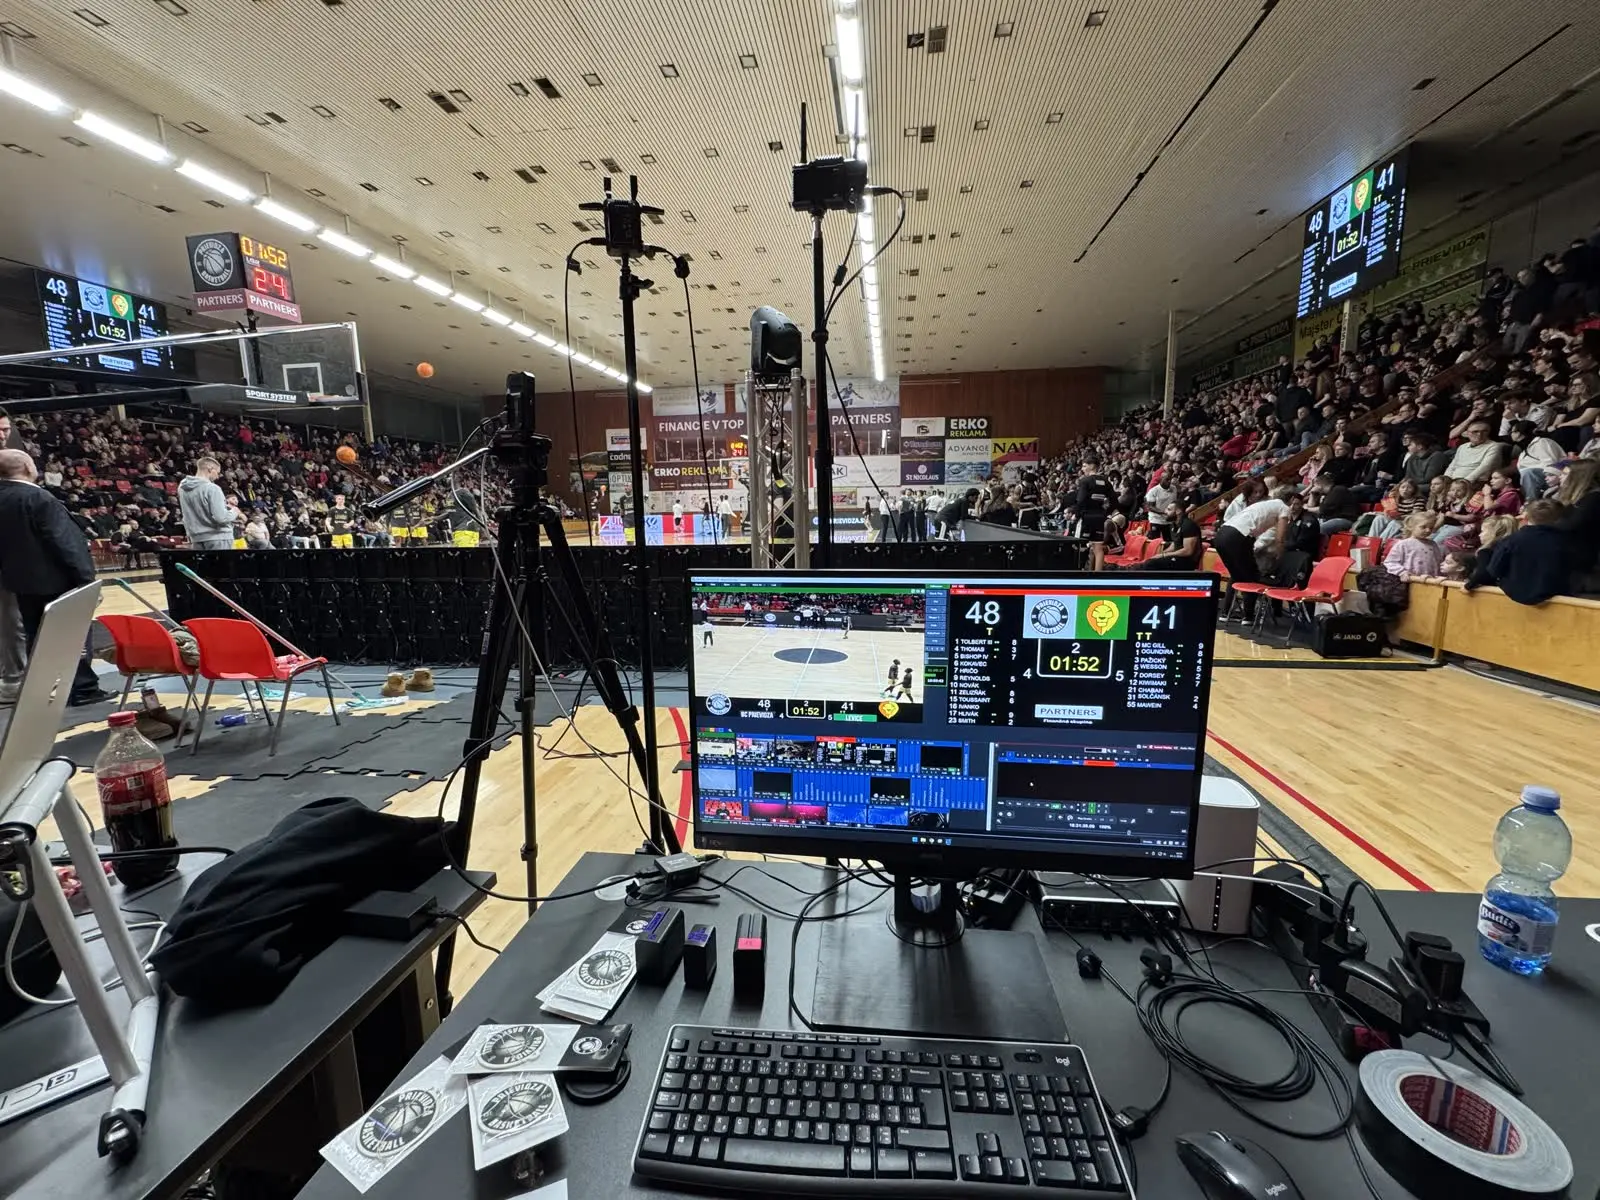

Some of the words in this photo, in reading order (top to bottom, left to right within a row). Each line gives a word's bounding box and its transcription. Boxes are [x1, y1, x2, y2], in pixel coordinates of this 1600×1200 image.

[1377, 163, 1394, 190] 41
[1309, 210, 1322, 233] 48
[1346, 224, 1351, 233] 2
[1338, 231, 1358, 252] 01:52
[1363, 236, 1367, 246] 5
[1413, 232, 1485, 270] PRIEVIDZA
[46, 278, 68, 296] 48
[254, 267, 286, 298] 24
[198, 294, 243, 306] PARTNERS
[139, 304, 155, 320] 41
[250, 296, 297, 317] PARTNERS
[100, 325, 126, 339] 01:52
[245, 390, 269, 398] SPORT
[832, 414, 891, 425] PARTNERS
[951, 419, 987, 429] ERKO
[659, 421, 710, 432] FINANCE
[713, 421, 720, 429] V
[722, 420, 744, 429] TOP
[993, 443, 1037, 453] NAVI
[654, 468, 680, 476] ERKO
[965, 601, 1000, 625] 48
[1142, 605, 1176, 629] 41
[1072, 643, 1080, 653] 2
[1050, 656, 1099, 671] 01:52
[1023, 668, 1031, 679] 4
[1115, 670, 1124, 681] 5
[758, 700, 771, 708] 48
[841, 702, 854, 710] 41
[793, 707, 819, 715] 01:52
[1040, 708, 1097, 716] PARTNERS
[580, 964, 608, 985] BASKETBALL
[1055, 1056, 1070, 1066] logi
[362, 1121, 405, 1151] BASKETBALL
